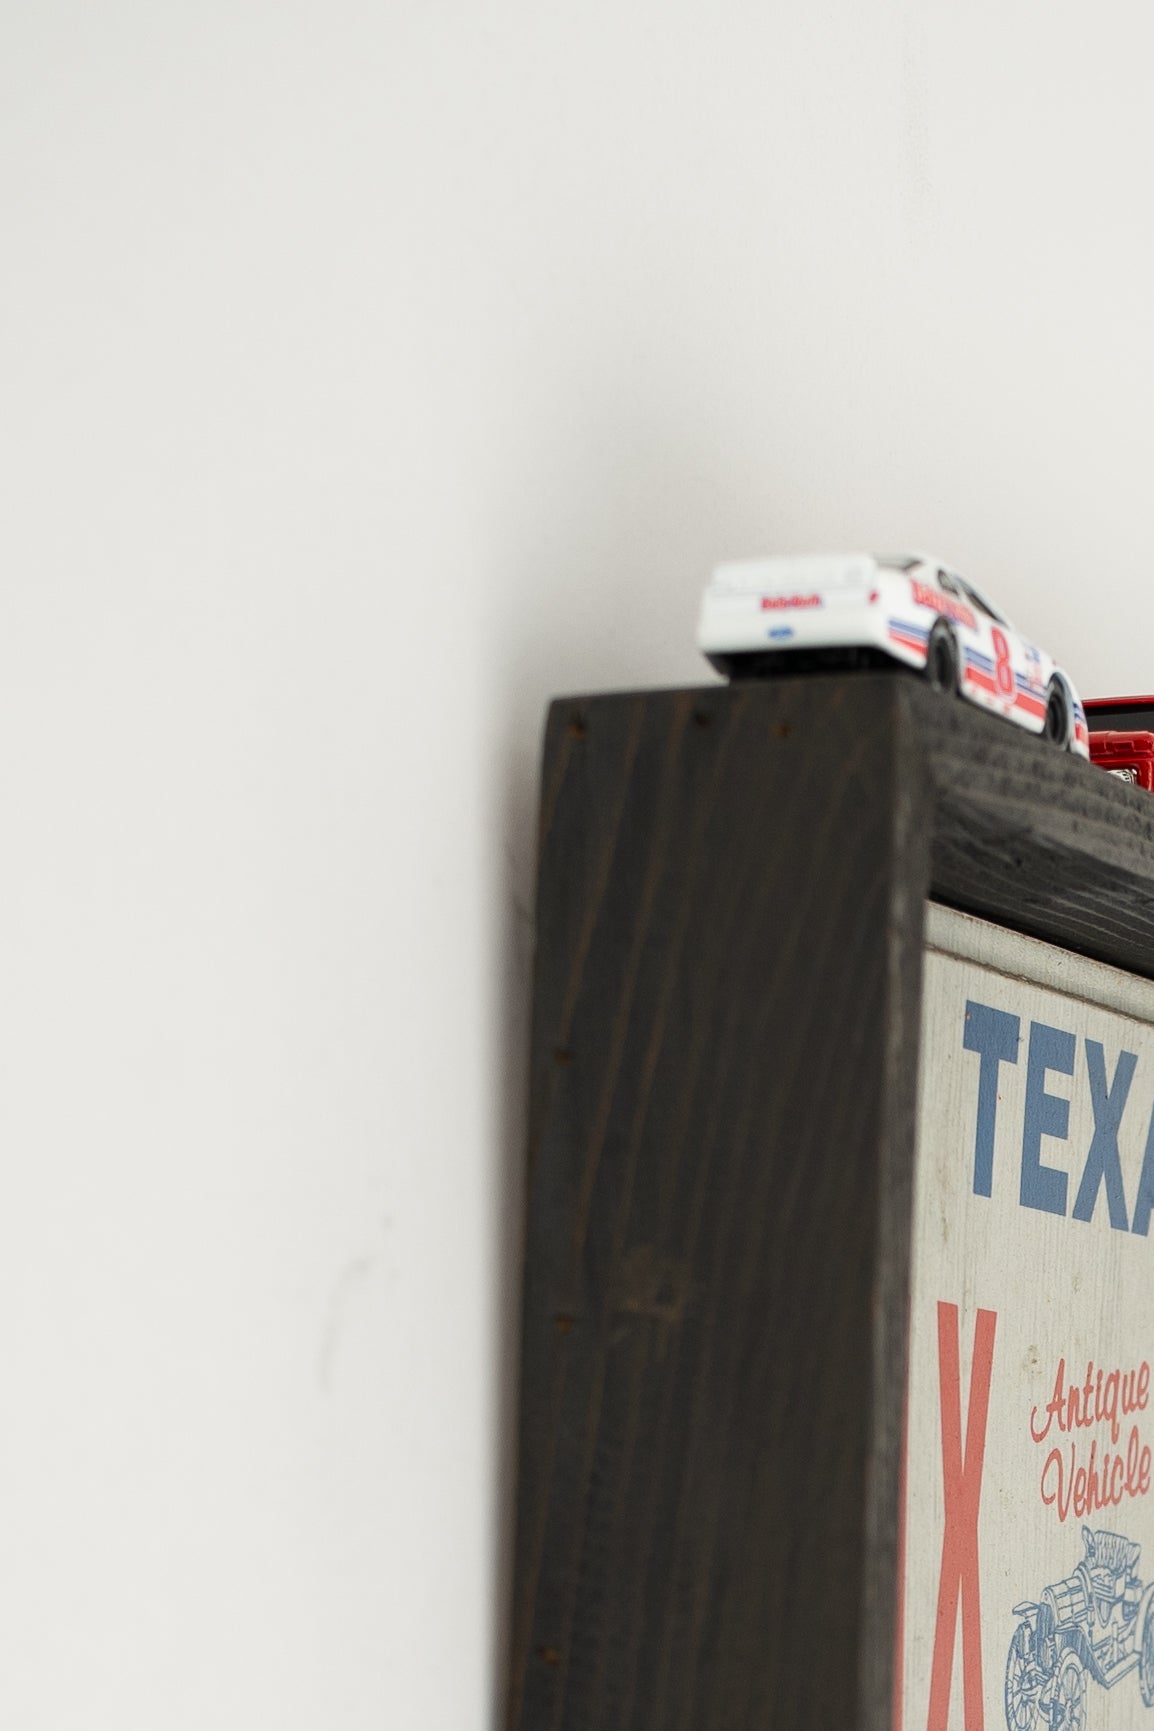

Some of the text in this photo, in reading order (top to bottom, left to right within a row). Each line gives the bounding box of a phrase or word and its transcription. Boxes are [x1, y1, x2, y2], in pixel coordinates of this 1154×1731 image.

[990, 625, 1013, 695] 8
[1030, 1358, 1150, 1444] Antique
[1041, 1425, 1151, 1522] Vehicle
